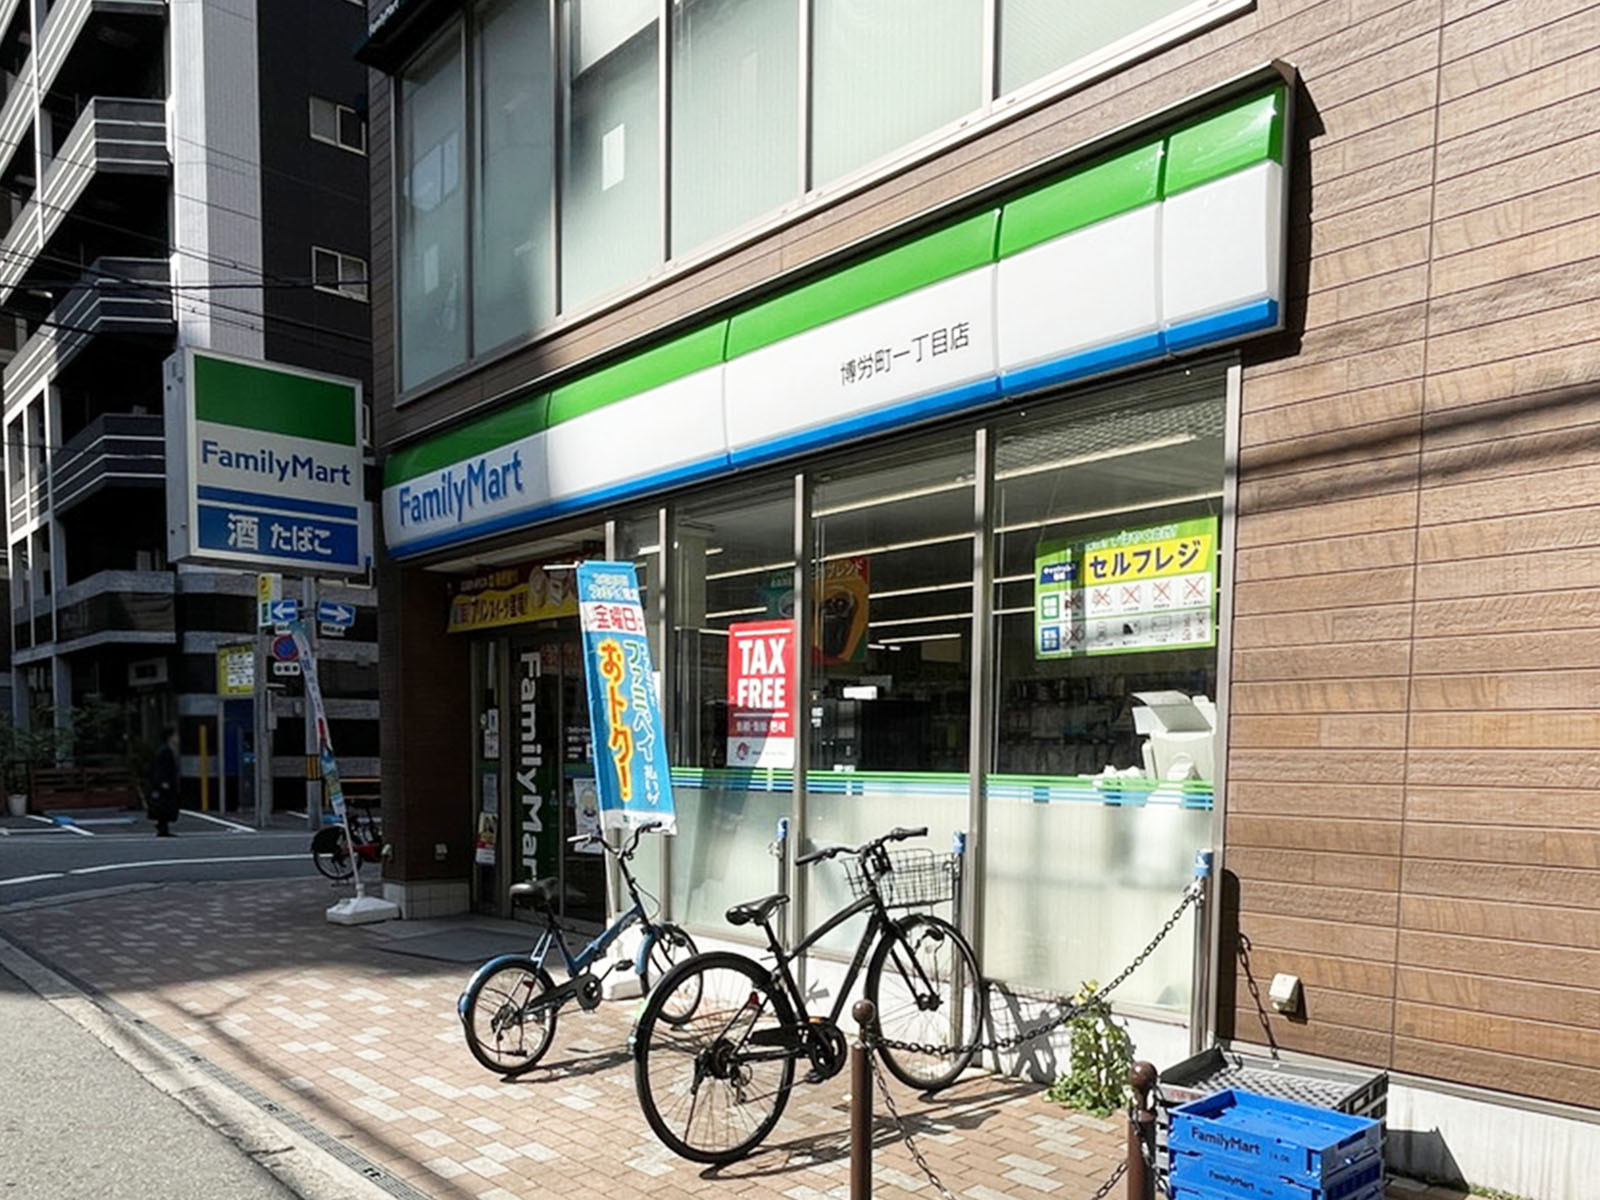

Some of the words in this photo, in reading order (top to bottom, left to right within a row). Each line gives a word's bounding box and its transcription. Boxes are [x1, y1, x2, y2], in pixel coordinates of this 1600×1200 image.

[840, 322, 969, 386] 博労町一丁目店
[202, 439, 350, 486] FamilyMart
[400, 450, 523, 527] FamilyMart
[227, 513, 258, 550] 酒
[270, 522, 332, 555] たばこ
[1089, 540, 1201, 579] セルフレジ
[738, 637, 786, 675] TAX
[737, 678, 786, 708] FREE
[516, 651, 543, 882] FamilyMar
[1191, 1126, 1261, 1156] FamilyMart
